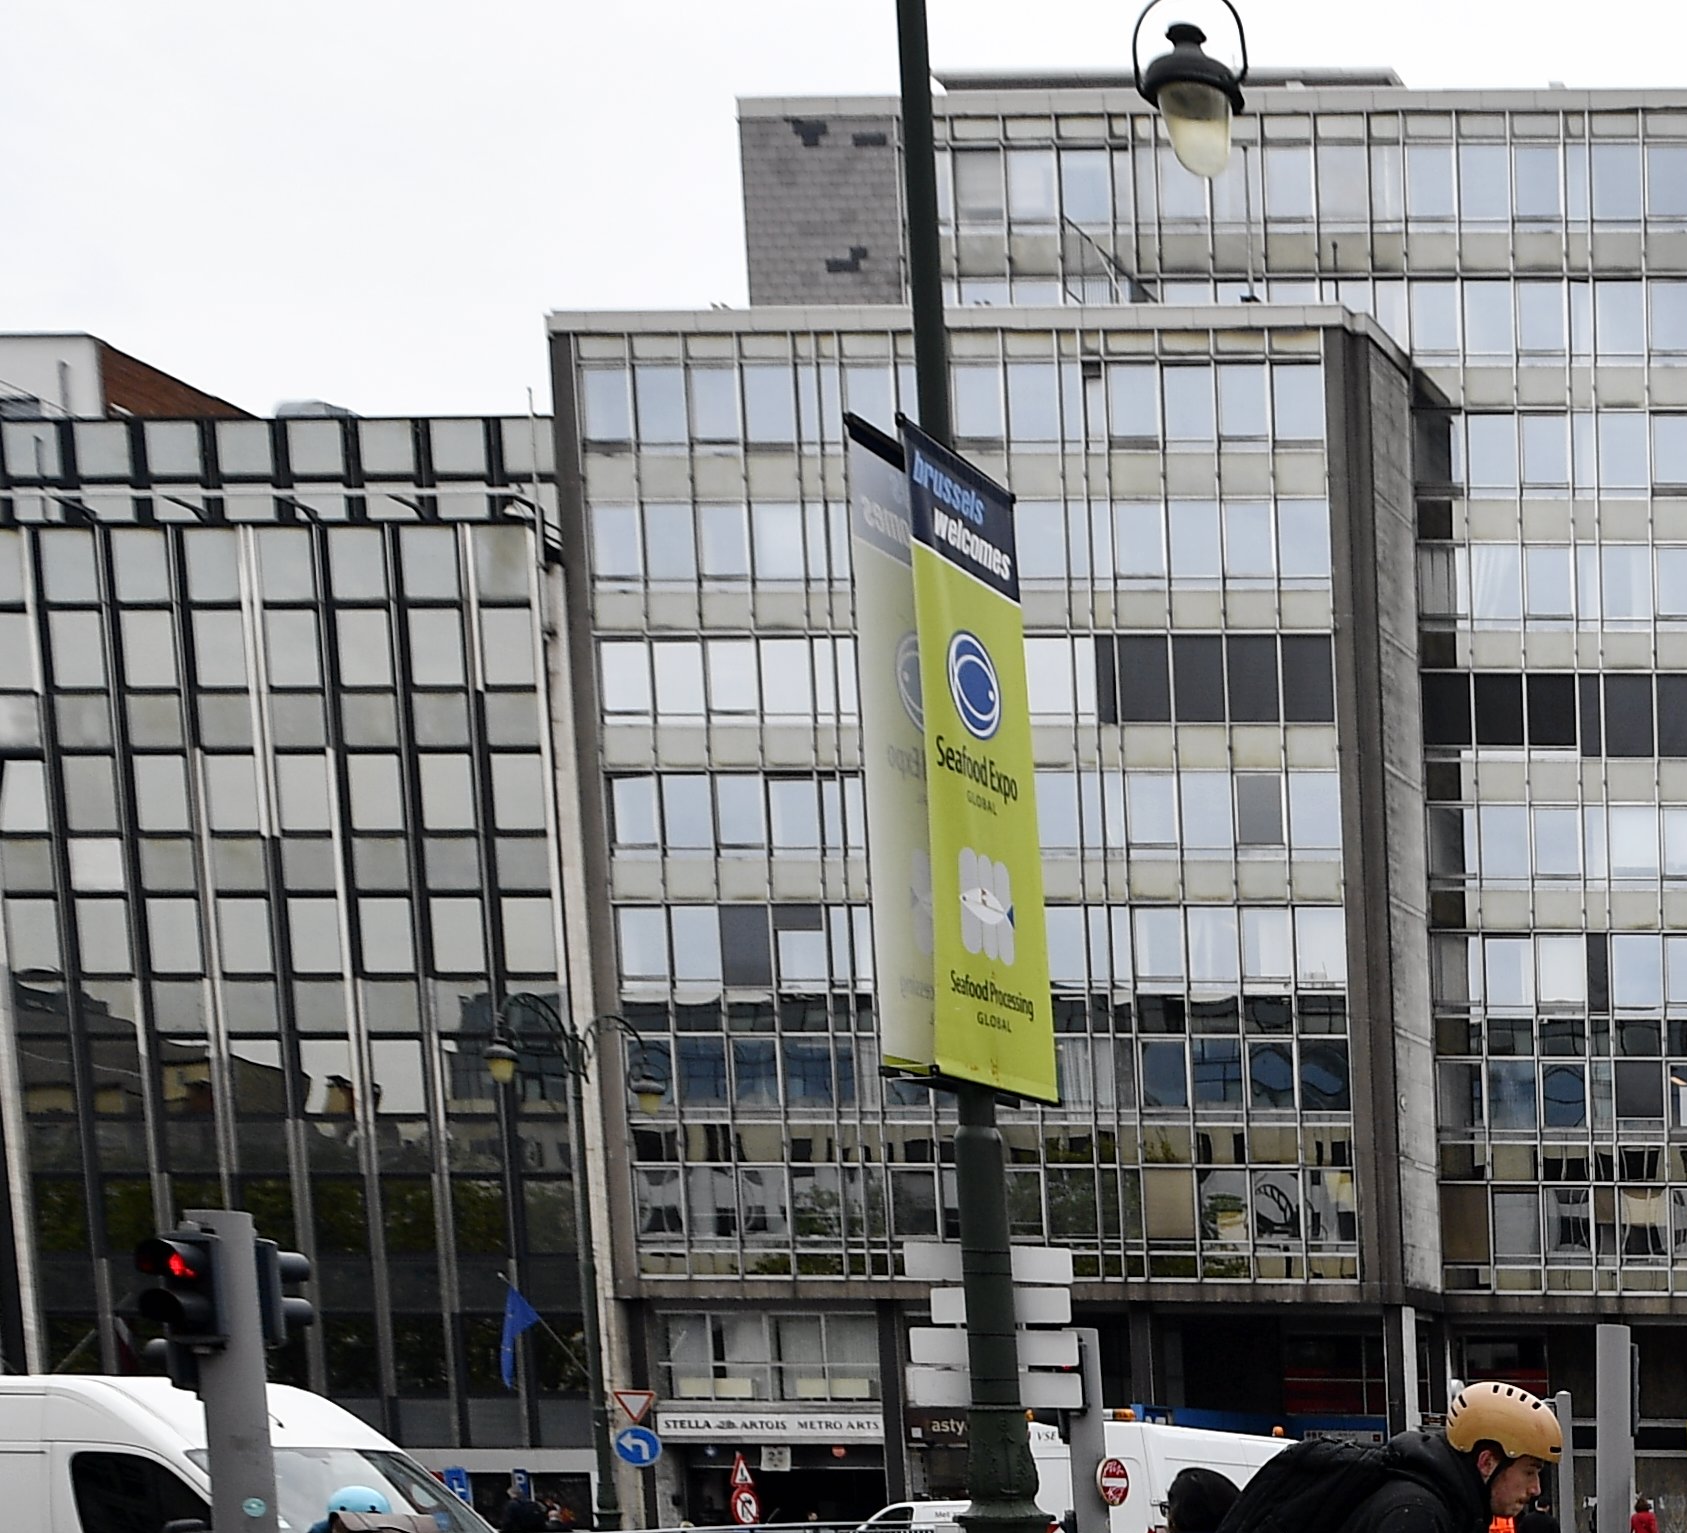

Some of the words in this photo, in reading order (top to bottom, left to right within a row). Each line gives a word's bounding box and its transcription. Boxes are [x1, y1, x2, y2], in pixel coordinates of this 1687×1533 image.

[913, 450, 985, 526] brussels
[934, 507, 1012, 581] welcomes
[936, 734, 988, 788] Seafood
[989, 759, 1018, 804] Expo
[966, 790, 998, 816] GLOBAL
[950, 969, 989, 1002] Seafood
[989, 980, 1034, 1022] Processing
[976, 1011, 1012, 1034] GLOBAL
[664, 1419, 711, 1430] STELLA
[740, 1419, 787, 1430] ARTOIS
[797, 1420, 843, 1431] METRO
[846, 1420, 879, 1431] ARTS
